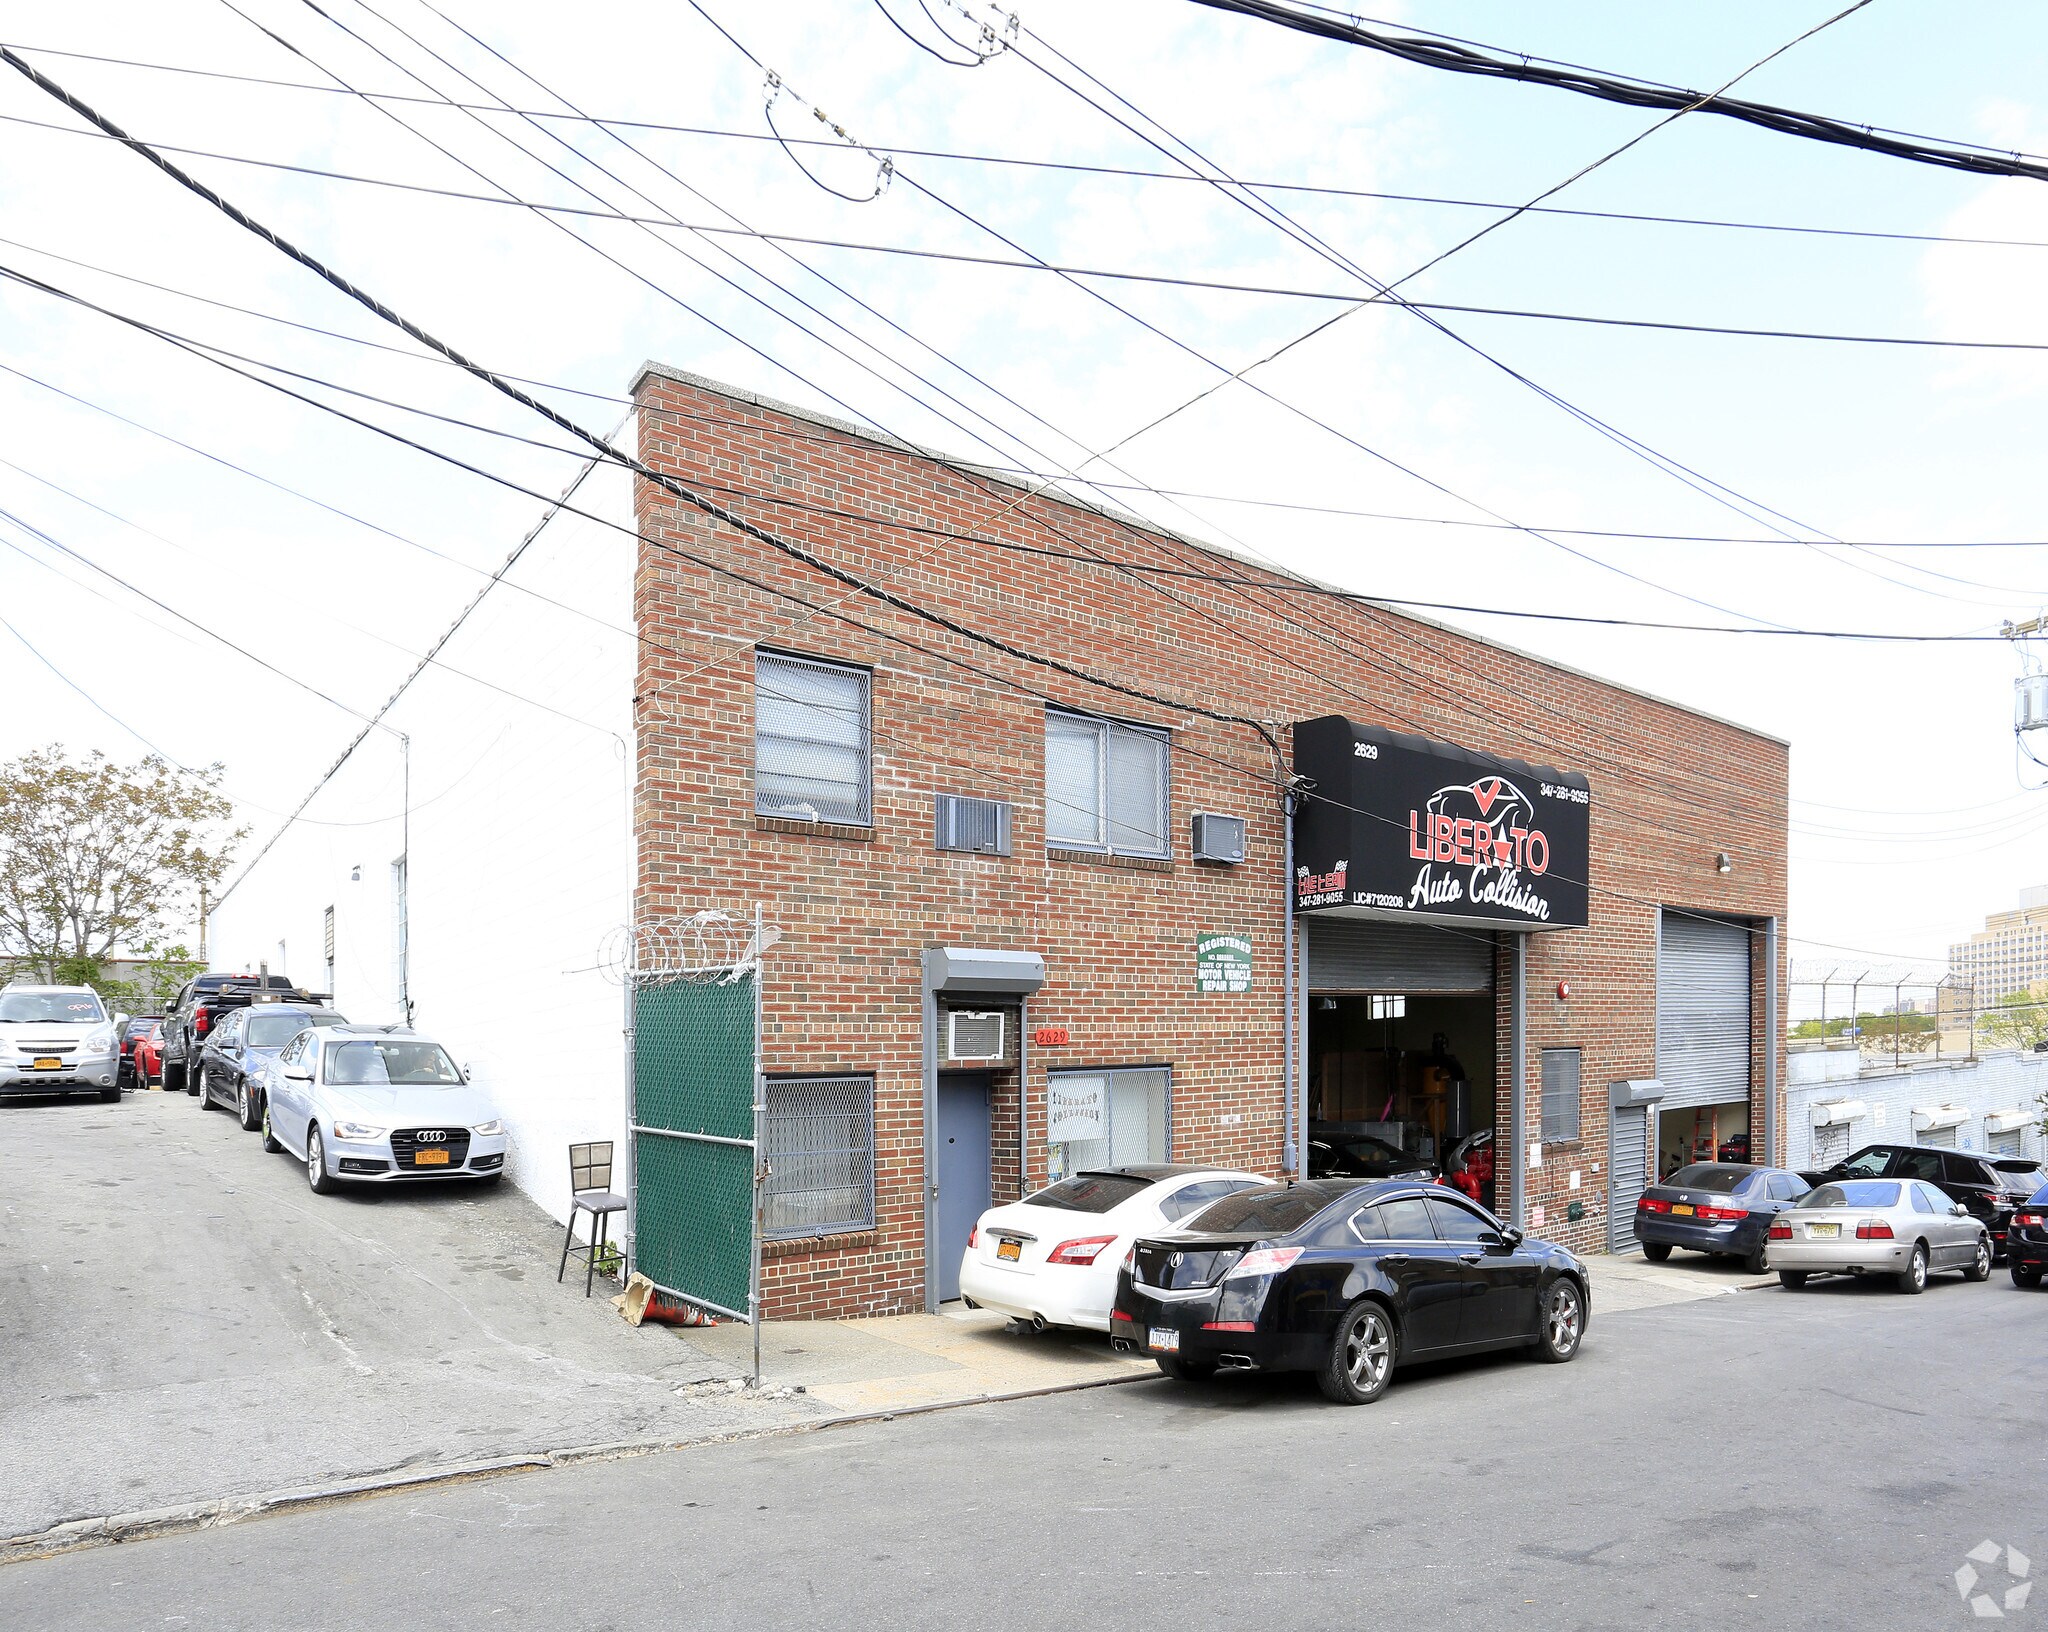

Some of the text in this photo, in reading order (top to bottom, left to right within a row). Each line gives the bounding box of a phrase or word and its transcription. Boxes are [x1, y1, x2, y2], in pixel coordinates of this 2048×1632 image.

[1353, 741, 1379, 760] 2629
[1540, 782, 1589, 804] 347-281-9055
[1298, 891, 1344, 907] 347-281-9055
[1353, 891, 1404, 908] LIC#7120208
[1407, 862, 1550, 921] Auto Collision
[1198, 936, 1251, 954] REGISTERED
[1198, 969, 1252, 981] MOTOR VEHICLE
[1202, 980, 1248, 992] REPAIR SHOP
[1039, 1031, 1066, 1044] 2629
